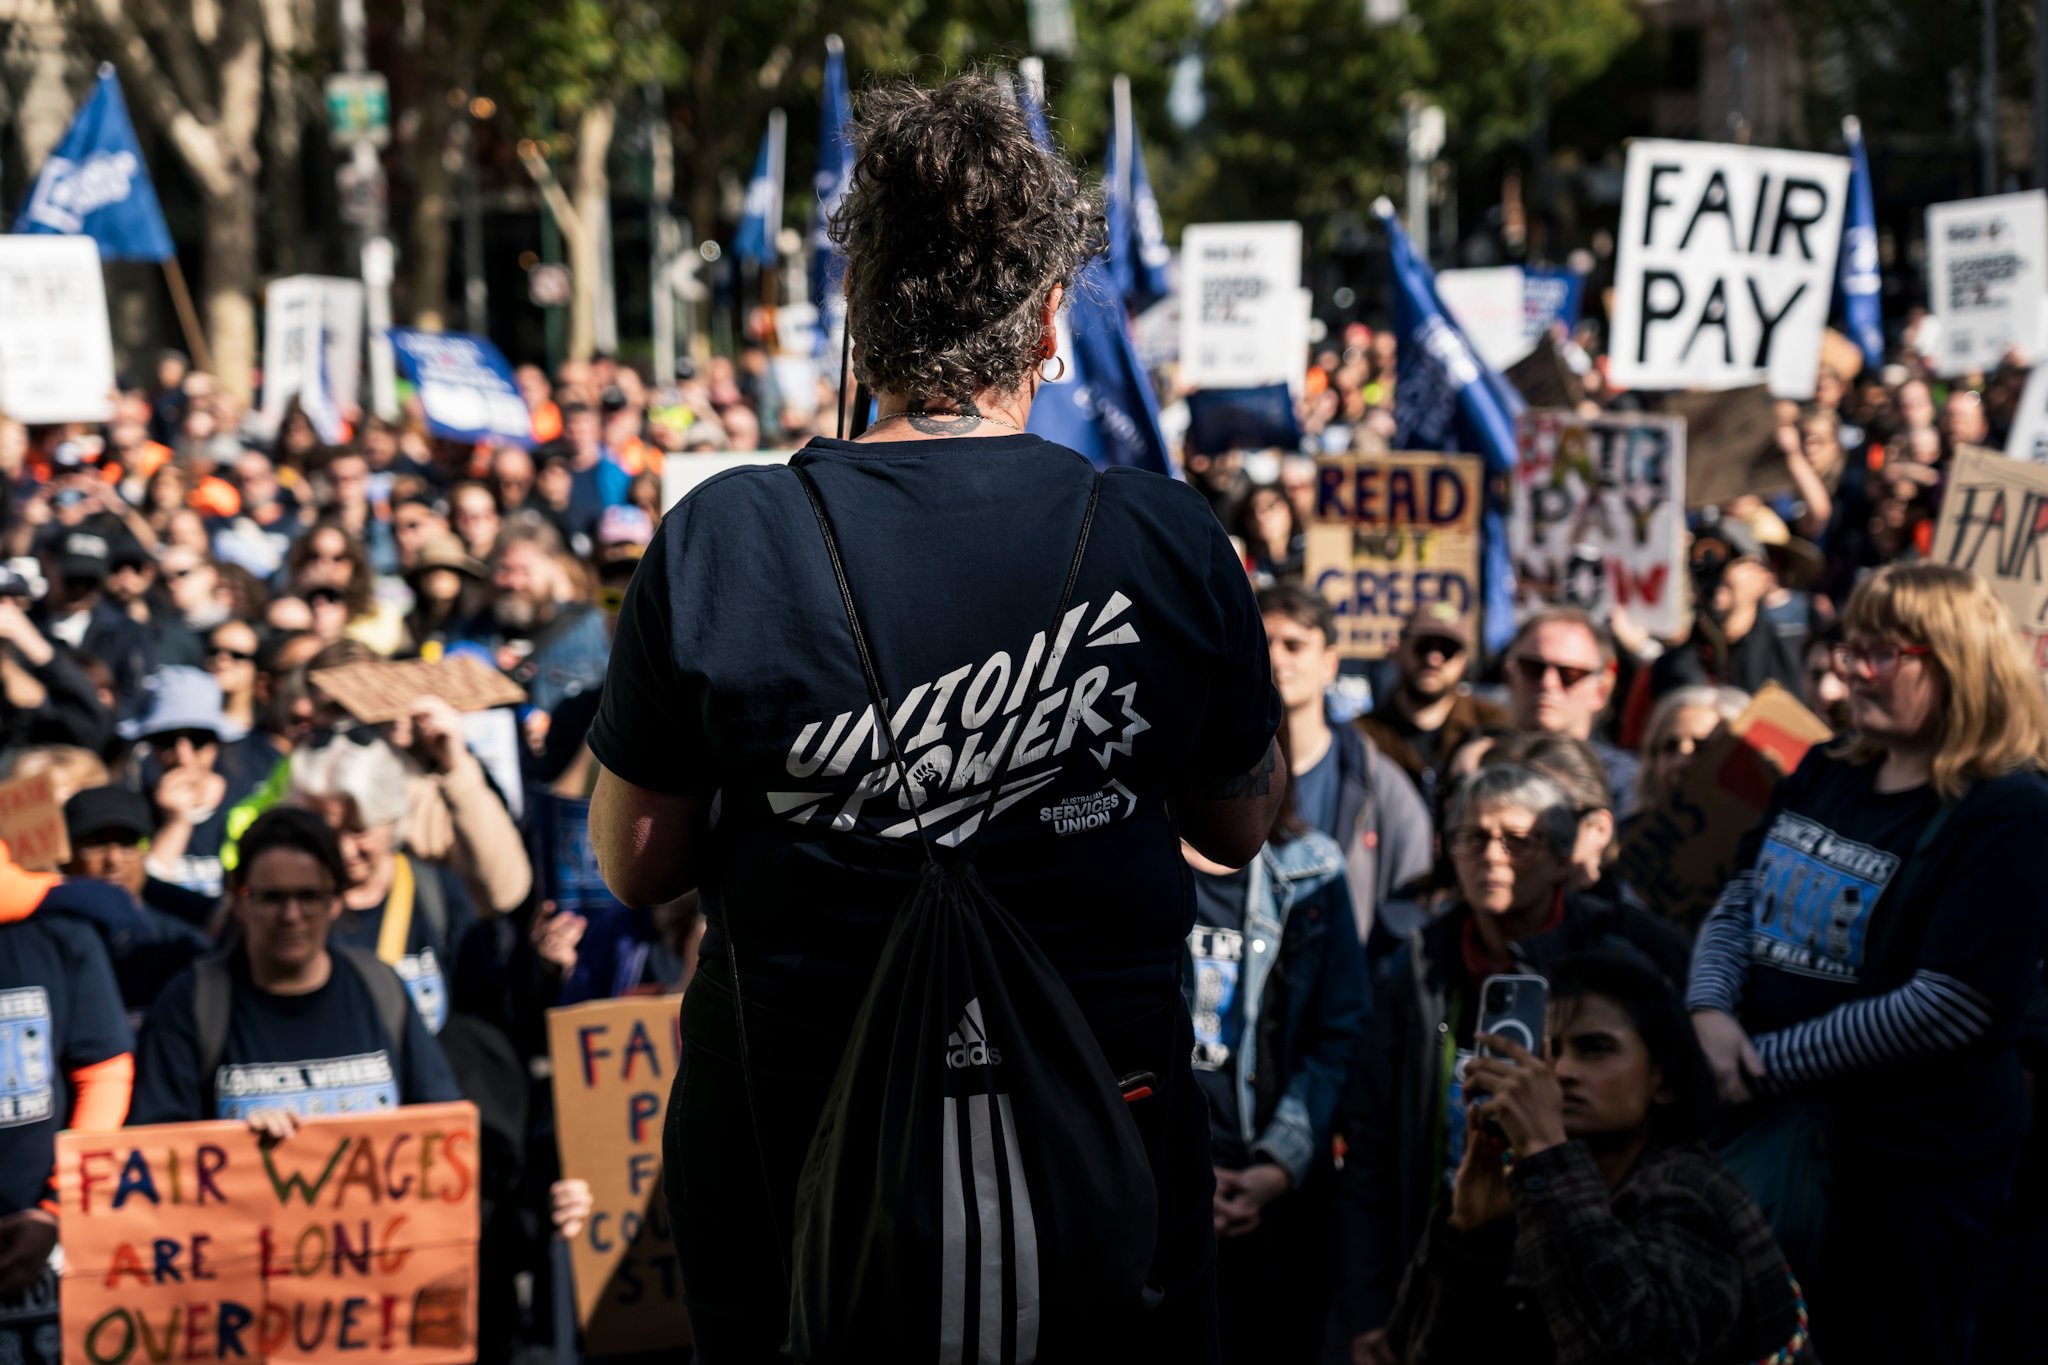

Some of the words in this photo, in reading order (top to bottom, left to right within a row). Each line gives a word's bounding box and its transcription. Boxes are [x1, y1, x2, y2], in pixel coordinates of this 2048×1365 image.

[1643, 164, 1827, 260] FAIR
[1638, 270, 1807, 367] PAY
[1318, 466, 1466, 524] READ
[1530, 486, 1662, 546] PAY
[1951, 482, 2048, 581] FAIR
[1316, 569, 1471, 617] GREED
[785, 601, 1090, 778] UNION
[830, 665, 1114, 831] POWER
[1040, 793, 1120, 821] SERVICES
[1054, 810, 1111, 834] UNION
[1061, 790, 1104, 805] AUSTRALIAN
[946, 1040, 1002, 1069] dids
[79, 1143, 229, 1214] FAIR
[260, 1130, 471, 1209] WAGES
[105, 1232, 216, 1289] ARE
[260, 1215, 411, 1280] LONG
[85, 1296, 396, 1365] OVERDUE!
